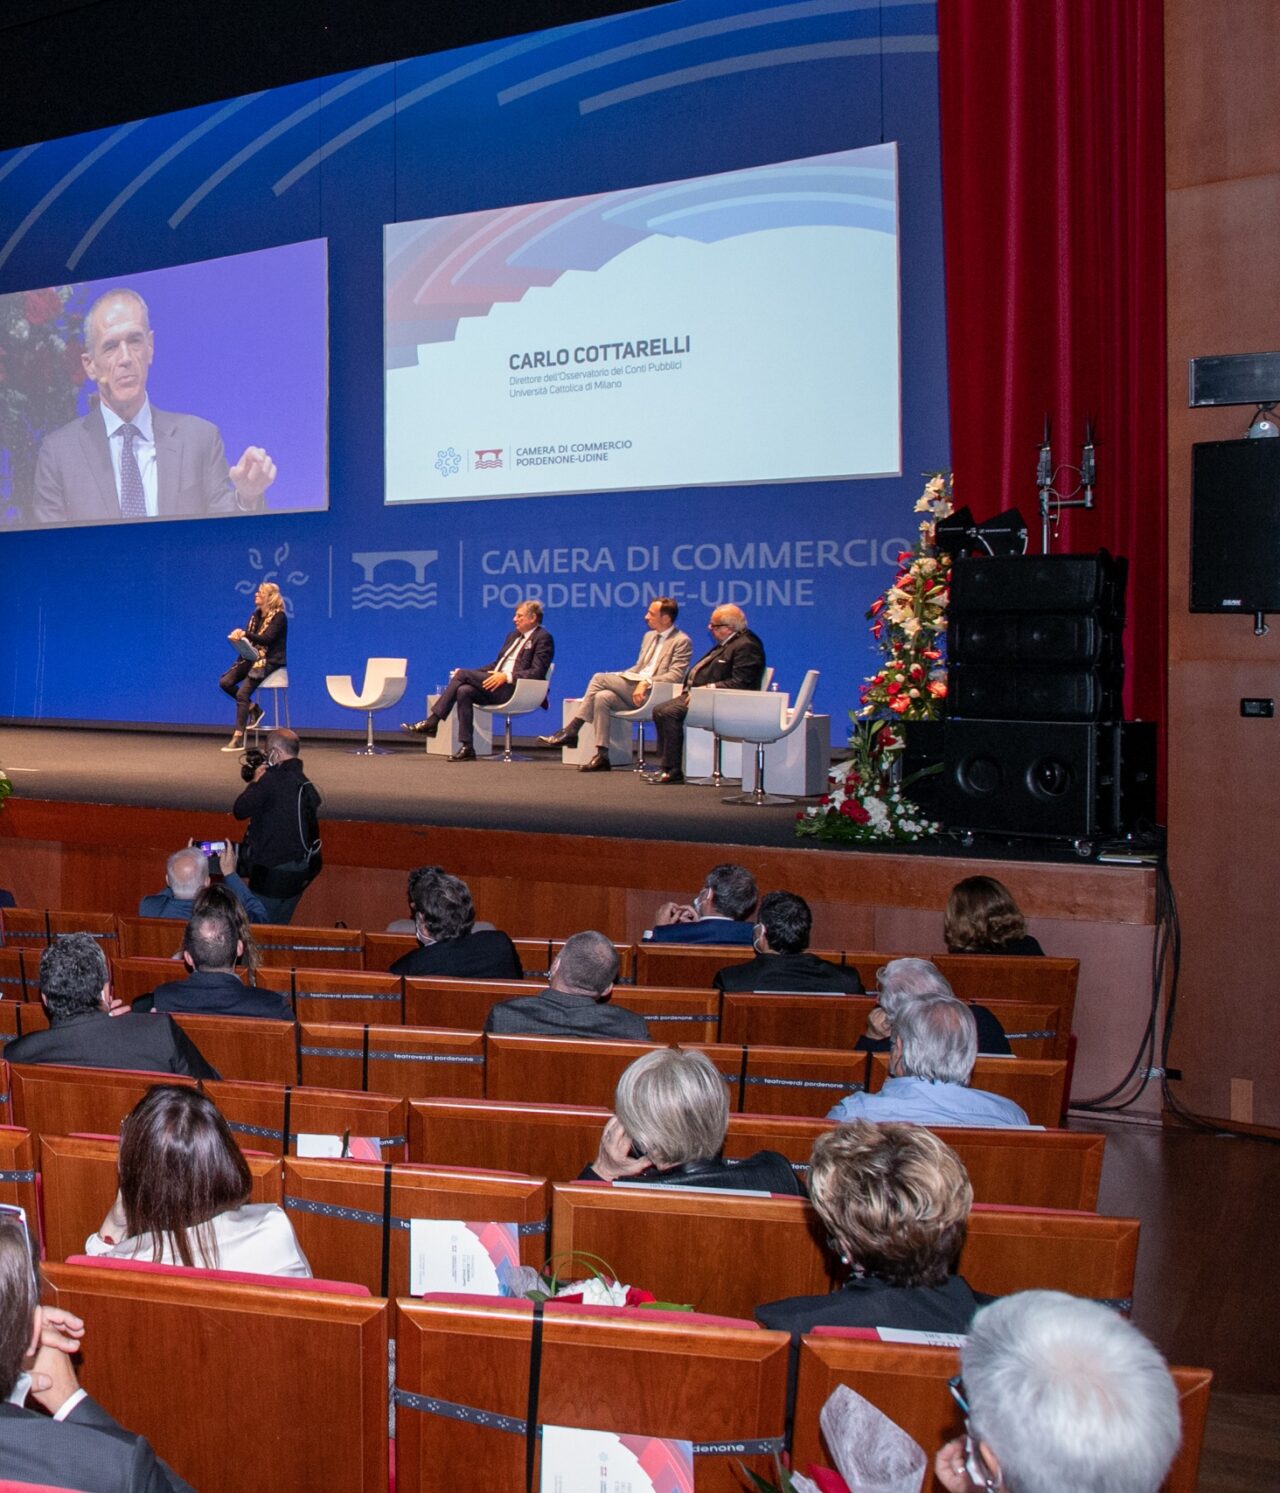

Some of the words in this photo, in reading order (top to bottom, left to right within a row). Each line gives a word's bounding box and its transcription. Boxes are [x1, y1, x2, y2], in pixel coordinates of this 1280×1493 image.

[509, 349, 569, 370] CARLO
[574, 335, 691, 364] COTTARELLI
[509, 373, 542, 386] Direttore
[543, 367, 609, 383] dell'Osservatorio
[610, 366, 624, 376] dei
[625, 363, 647, 374] Conti
[648, 360, 682, 373] Pubblici
[509, 385, 548, 398] Università
[549, 383, 583, 395] Cattolica
[585, 382, 593, 392] di
[594, 379, 622, 390] Milano
[516, 445, 556, 457] CAMERA
[557, 444, 569, 454] DI
[570, 440, 633, 453] COMMERCIO
[516, 452, 609, 467] PORDENONE-UDINE
[481, 547, 616, 575] CAMERA
[627, 545, 659, 571] DI
[671, 537, 912, 571] COMMERCIO
[482, 578, 815, 609] PORDENONE-UDINE
[394, 1053, 433, 1061] teatroverdi
[764, 1078, 803, 1086] teatroverdi
[803, 1081, 844, 1089] pordenone
[692, 1442, 745, 1454] denone
